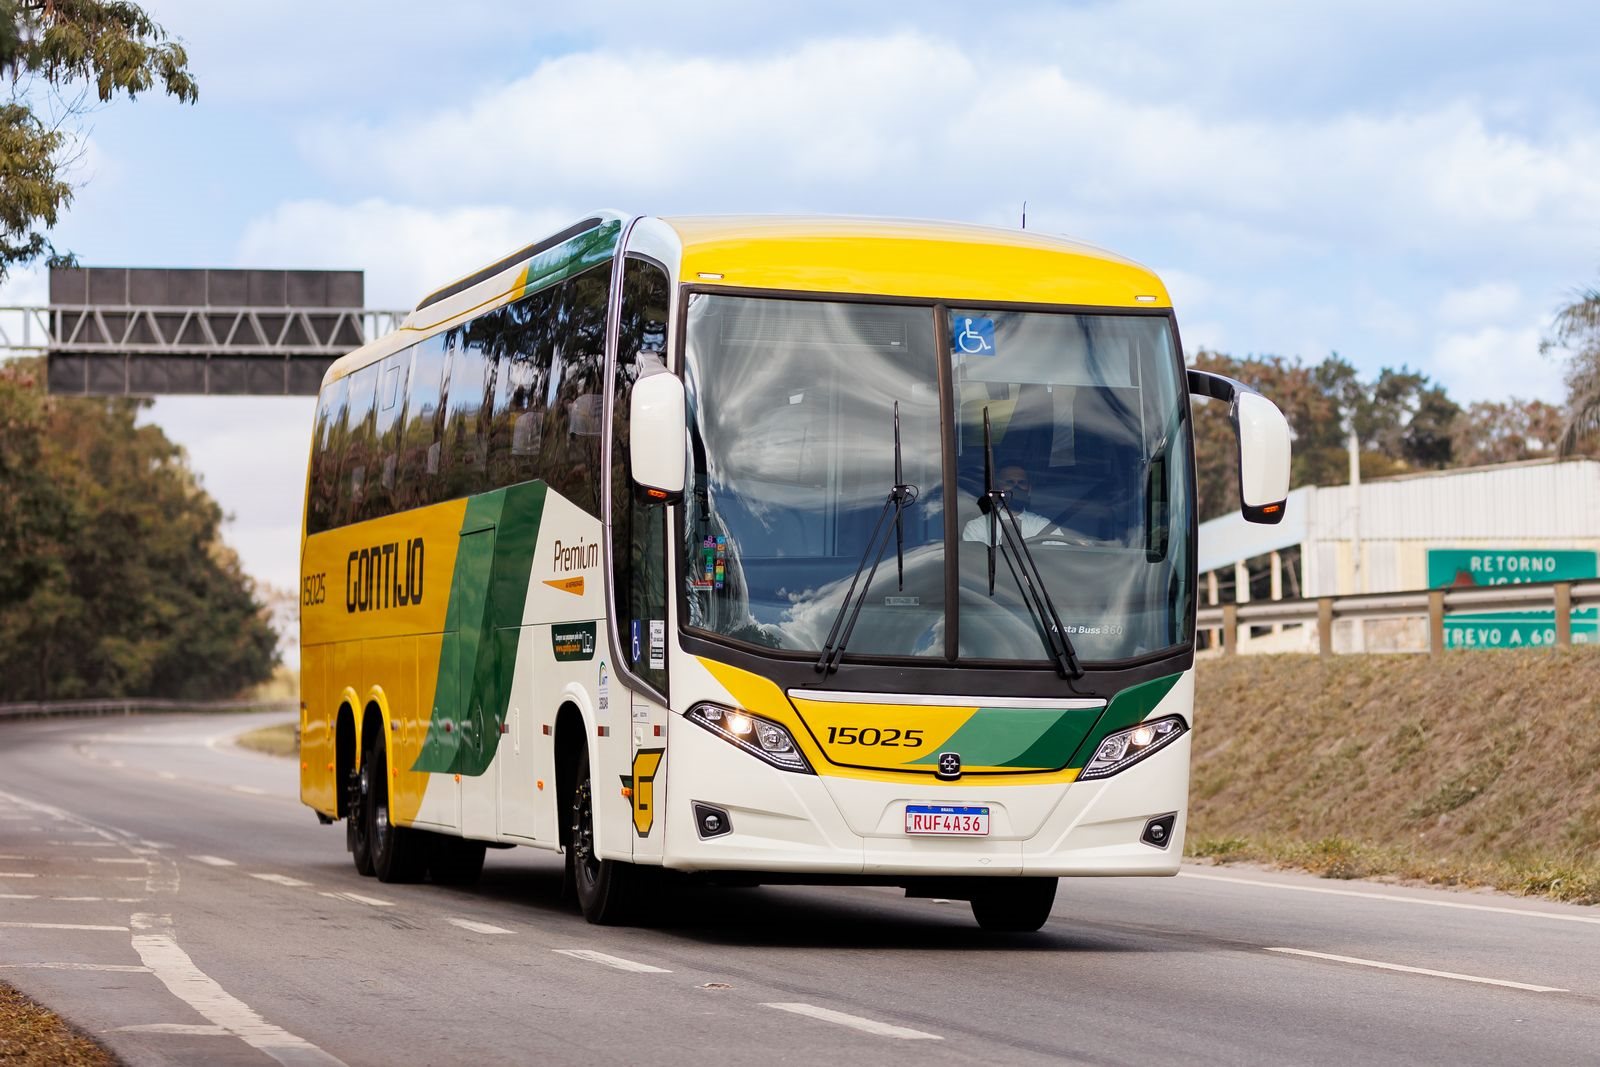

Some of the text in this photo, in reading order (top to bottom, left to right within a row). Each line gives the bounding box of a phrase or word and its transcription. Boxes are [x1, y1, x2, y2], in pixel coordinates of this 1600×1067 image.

[553, 536, 599, 573] Premium
[1469, 556, 1556, 573] RETORNO
[346, 537, 424, 614] GONTIJO
[303, 572, 327, 606] 15025
[1078, 625, 1101, 634] Buss
[1102, 624, 1124, 635] 360
[1443, 628, 1502, 645] TREVO
[1509, 629, 1522, 644] A
[826, 726, 924, 748] 15025
[913, 815, 981, 832] RUF4A36
